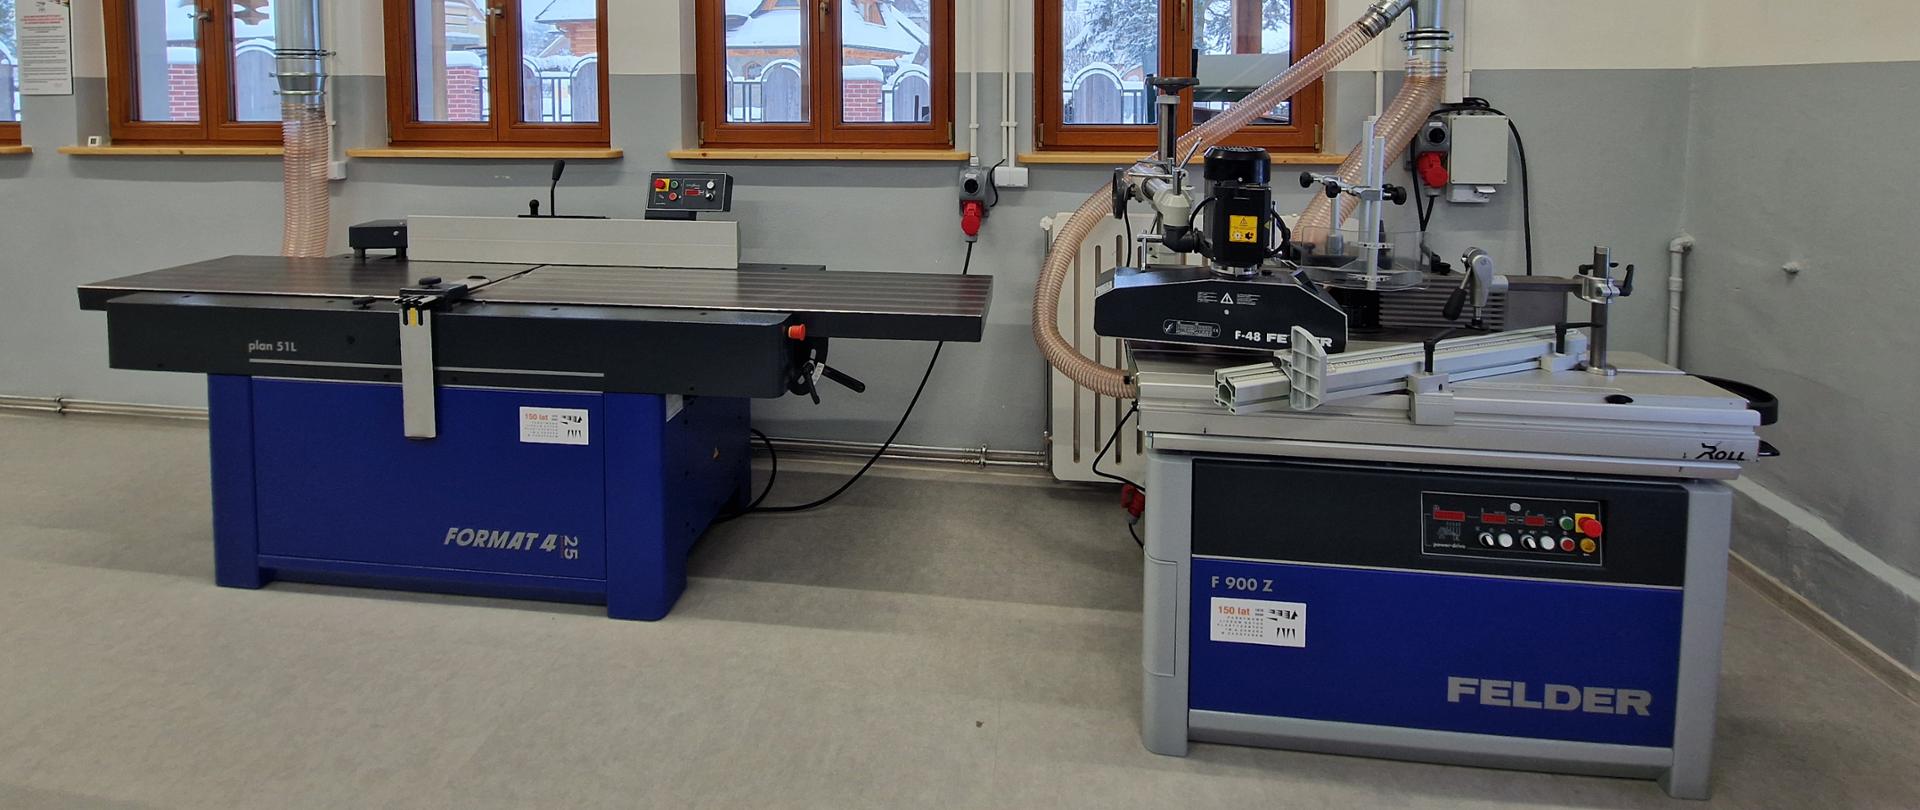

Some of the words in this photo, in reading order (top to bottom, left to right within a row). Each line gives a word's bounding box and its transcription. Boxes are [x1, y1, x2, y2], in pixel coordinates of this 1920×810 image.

[248, 340, 273, 353] plan
[276, 340, 297, 352] 51L
[1234, 330, 1261, 342] F-48
[1266, 332, 1333, 348] FER
[444, 527, 539, 551] FORMAT
[539, 533, 558, 552] 4
[564, 535, 579, 560] 25
[1211, 575, 1220, 589] F
[1225, 576, 1258, 592] 900
[1262, 579, 1273, 593] Z
[1218, 605, 1235, 615] 150
[1237, 606, 1250, 616] lat
[1447, 675, 1653, 718] FELDER
